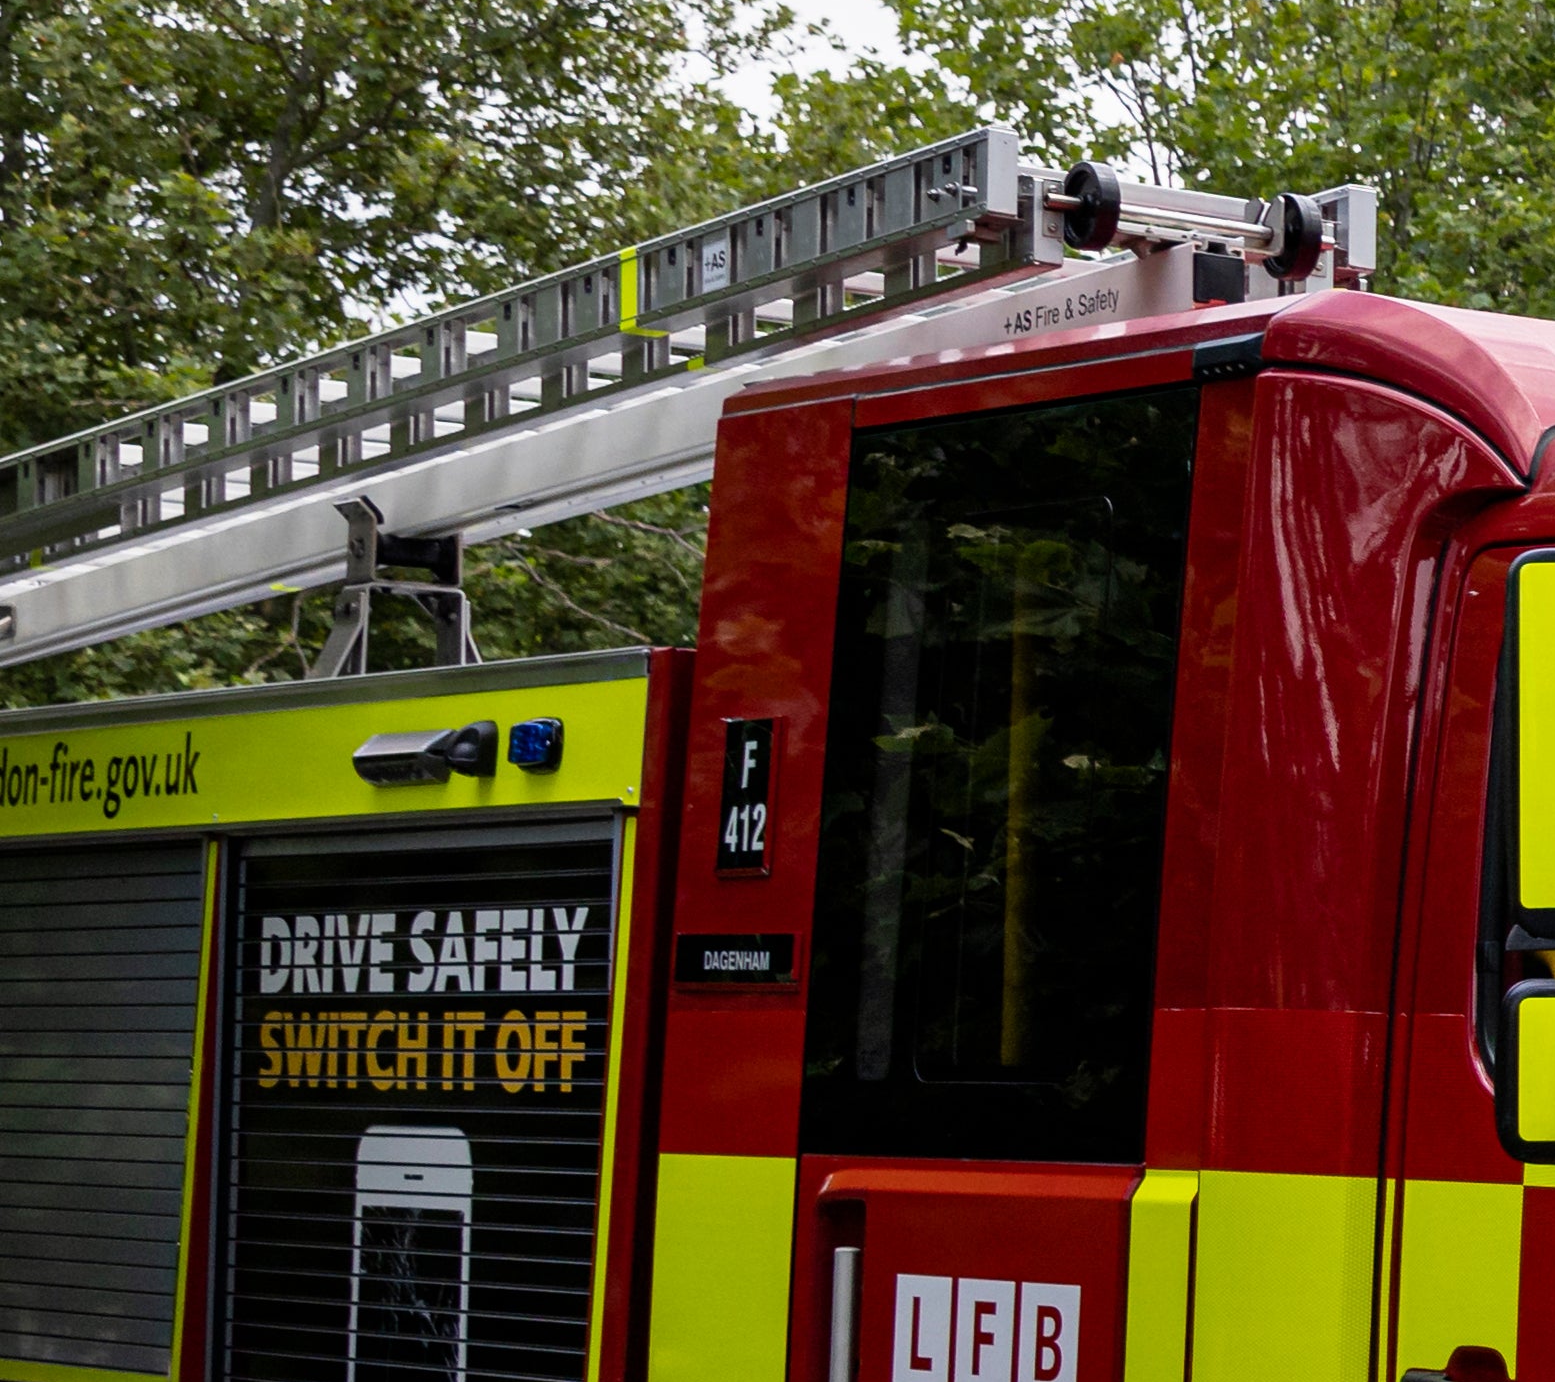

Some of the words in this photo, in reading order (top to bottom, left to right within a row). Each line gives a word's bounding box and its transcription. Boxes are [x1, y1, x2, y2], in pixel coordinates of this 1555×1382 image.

[1035, 304, 1061, 328] Fire
[1064, 297, 1075, 320] &
[1078, 287, 1120, 317] Safety
[741, 740, 759, 790] F
[723, 802, 768, 853] 412
[259, 914, 397, 994] DRIVE
[407, 906, 590, 993] SAFELY
[703, 951, 770, 971] DAGENHAM
[258, 1010, 429, 1092] SWITCH
[442, 1012, 486, 1092] IT
[495, 1009, 588, 1094] OFF
